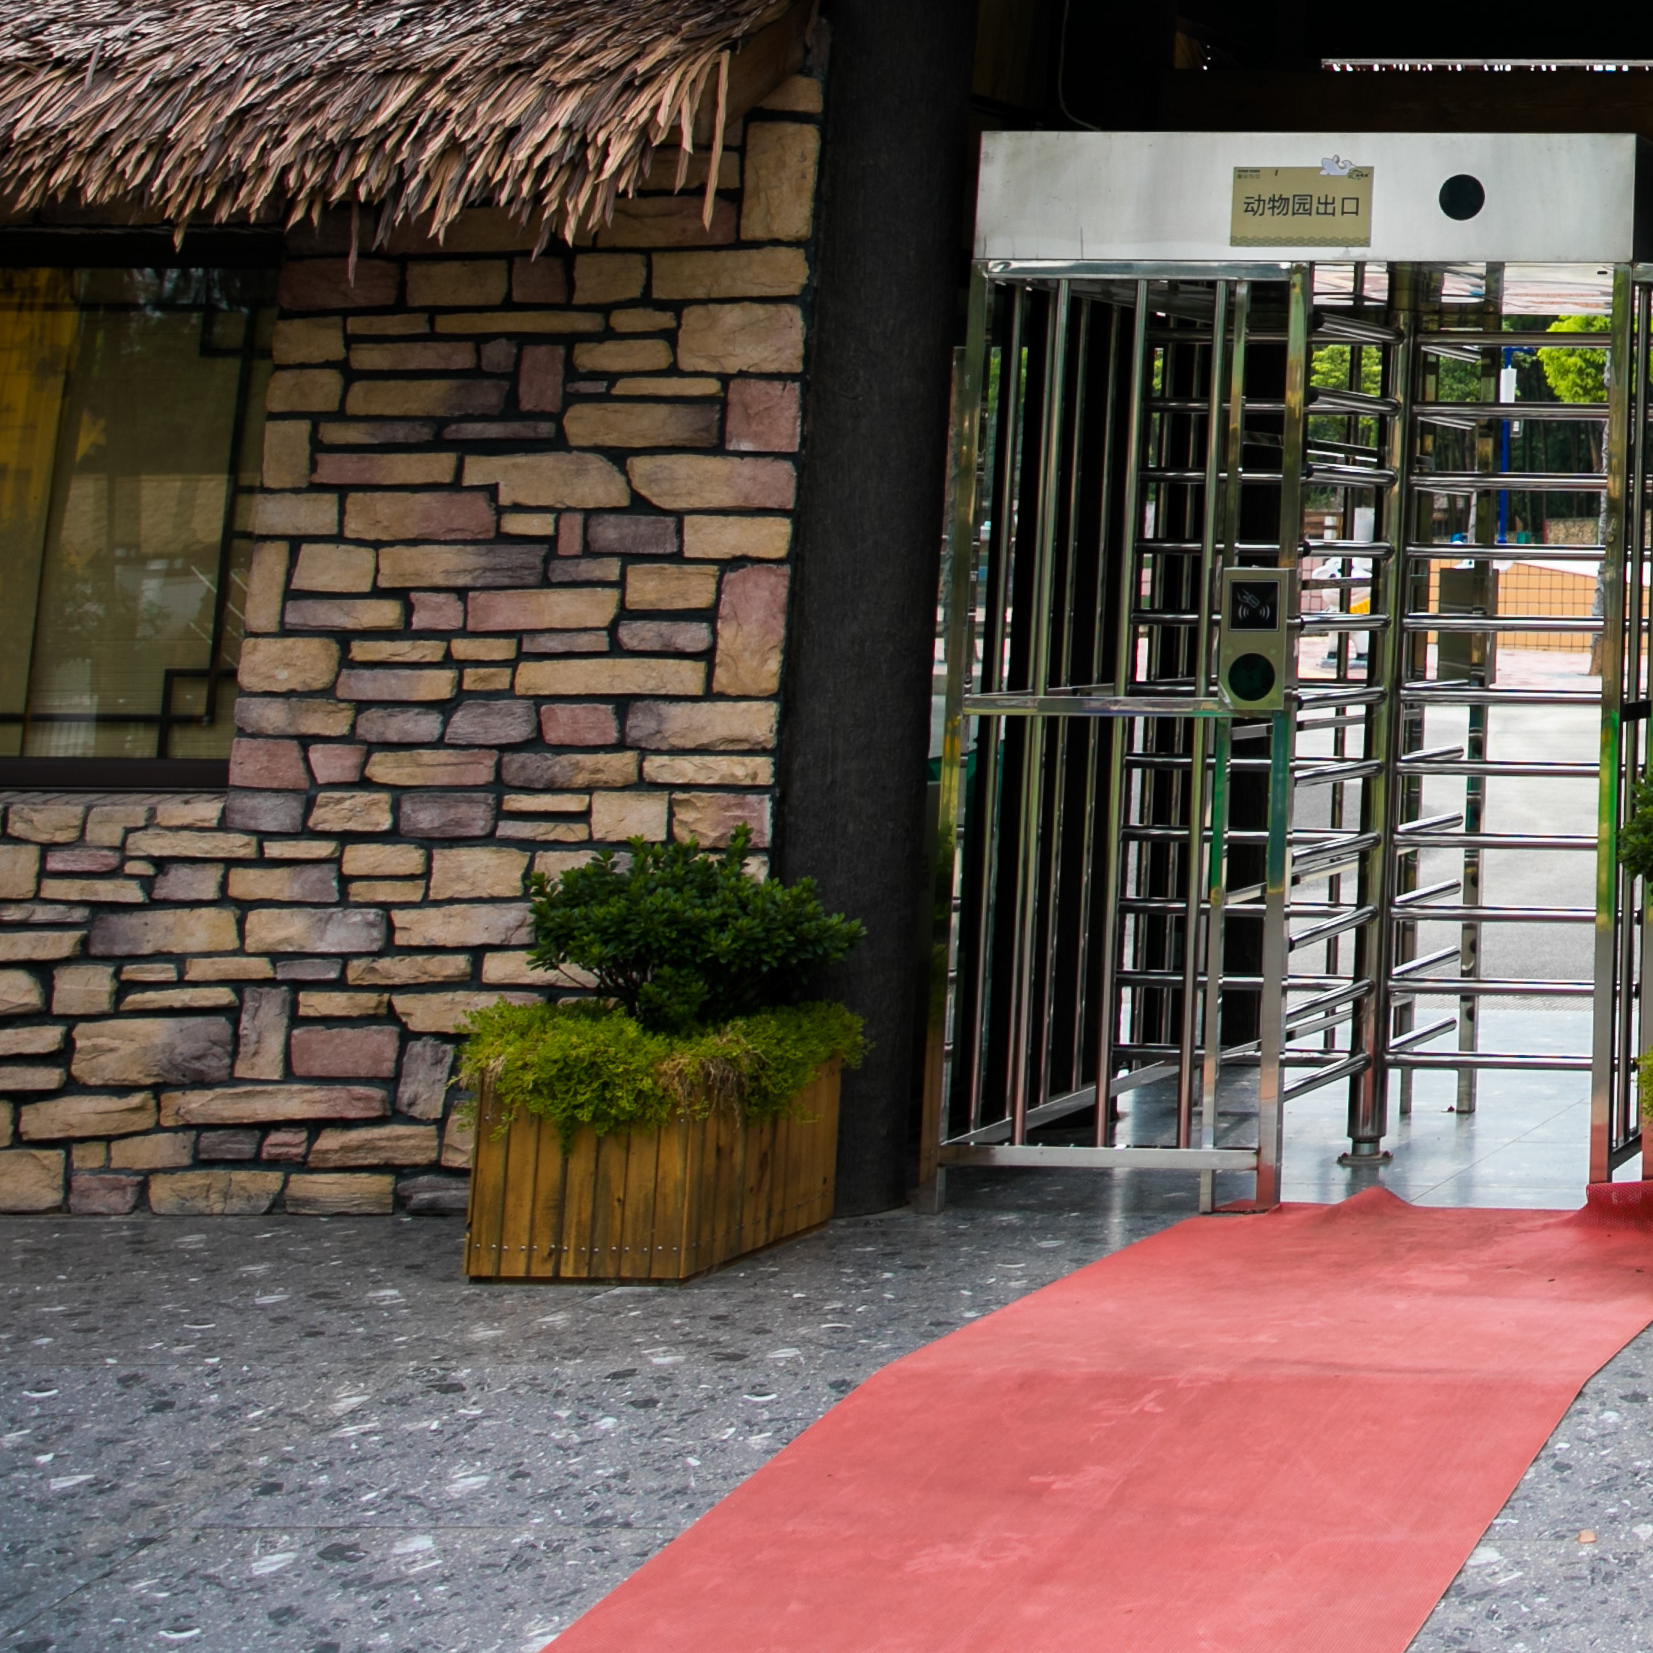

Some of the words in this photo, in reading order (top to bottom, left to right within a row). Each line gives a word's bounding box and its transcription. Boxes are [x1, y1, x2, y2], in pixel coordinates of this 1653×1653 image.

[1243, 193, 1360, 217] 动物园出口
